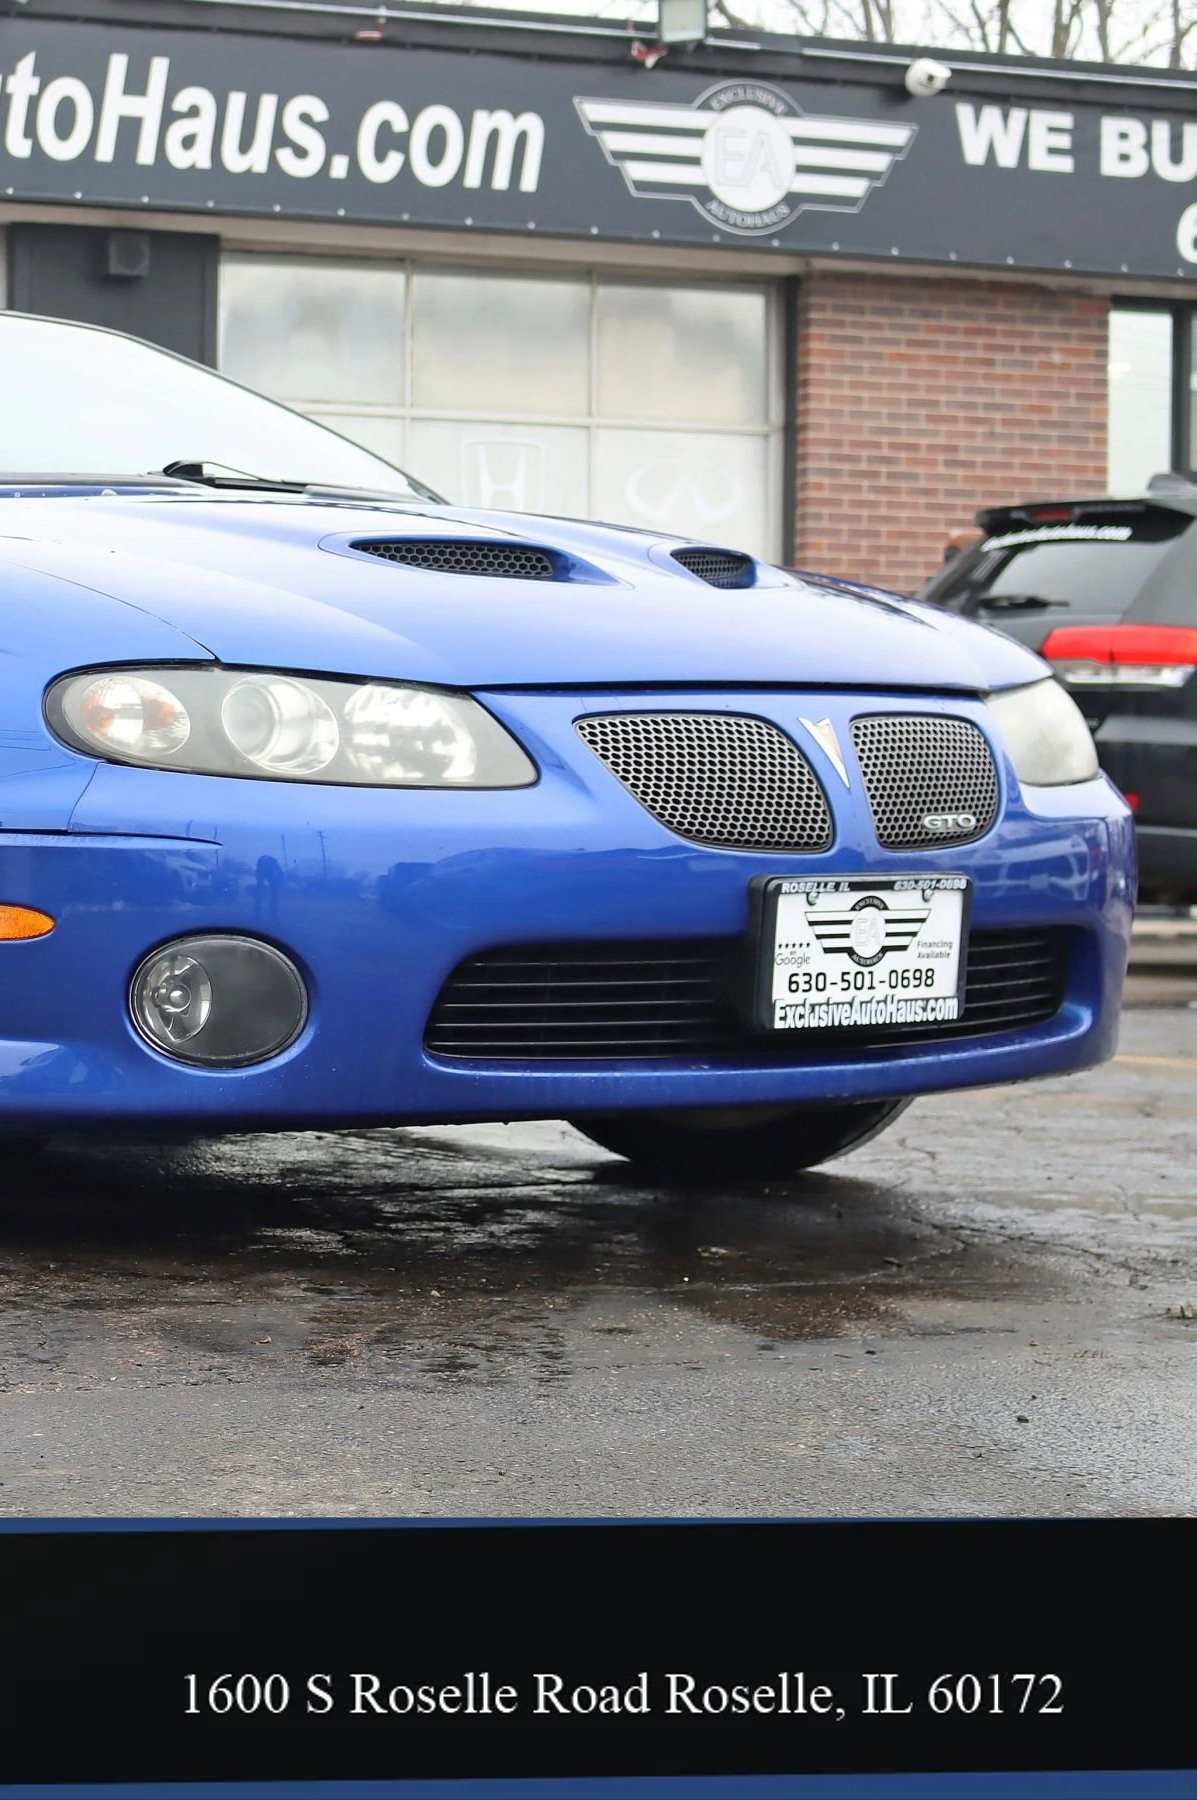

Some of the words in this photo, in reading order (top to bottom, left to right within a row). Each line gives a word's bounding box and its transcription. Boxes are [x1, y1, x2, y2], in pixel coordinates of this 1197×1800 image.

[955, 102, 1074, 173] WE
[1100, 116, 1197, 182] BU
[714, 127, 784, 191] EA
[923, 813, 977, 829] GTO
[781, 881, 836, 894] ROSELLE
[839, 881, 851, 892] IL
[894, 878, 968, 891] 630-501-0698
[917, 940, 953, 950] Financing
[775, 952, 811, 968] Google
[917, 950, 951, 959] Available
[788, 968, 935, 993] 630-501-0698
[774, 997, 958, 1029] ExclusiveAutoHaus.com
